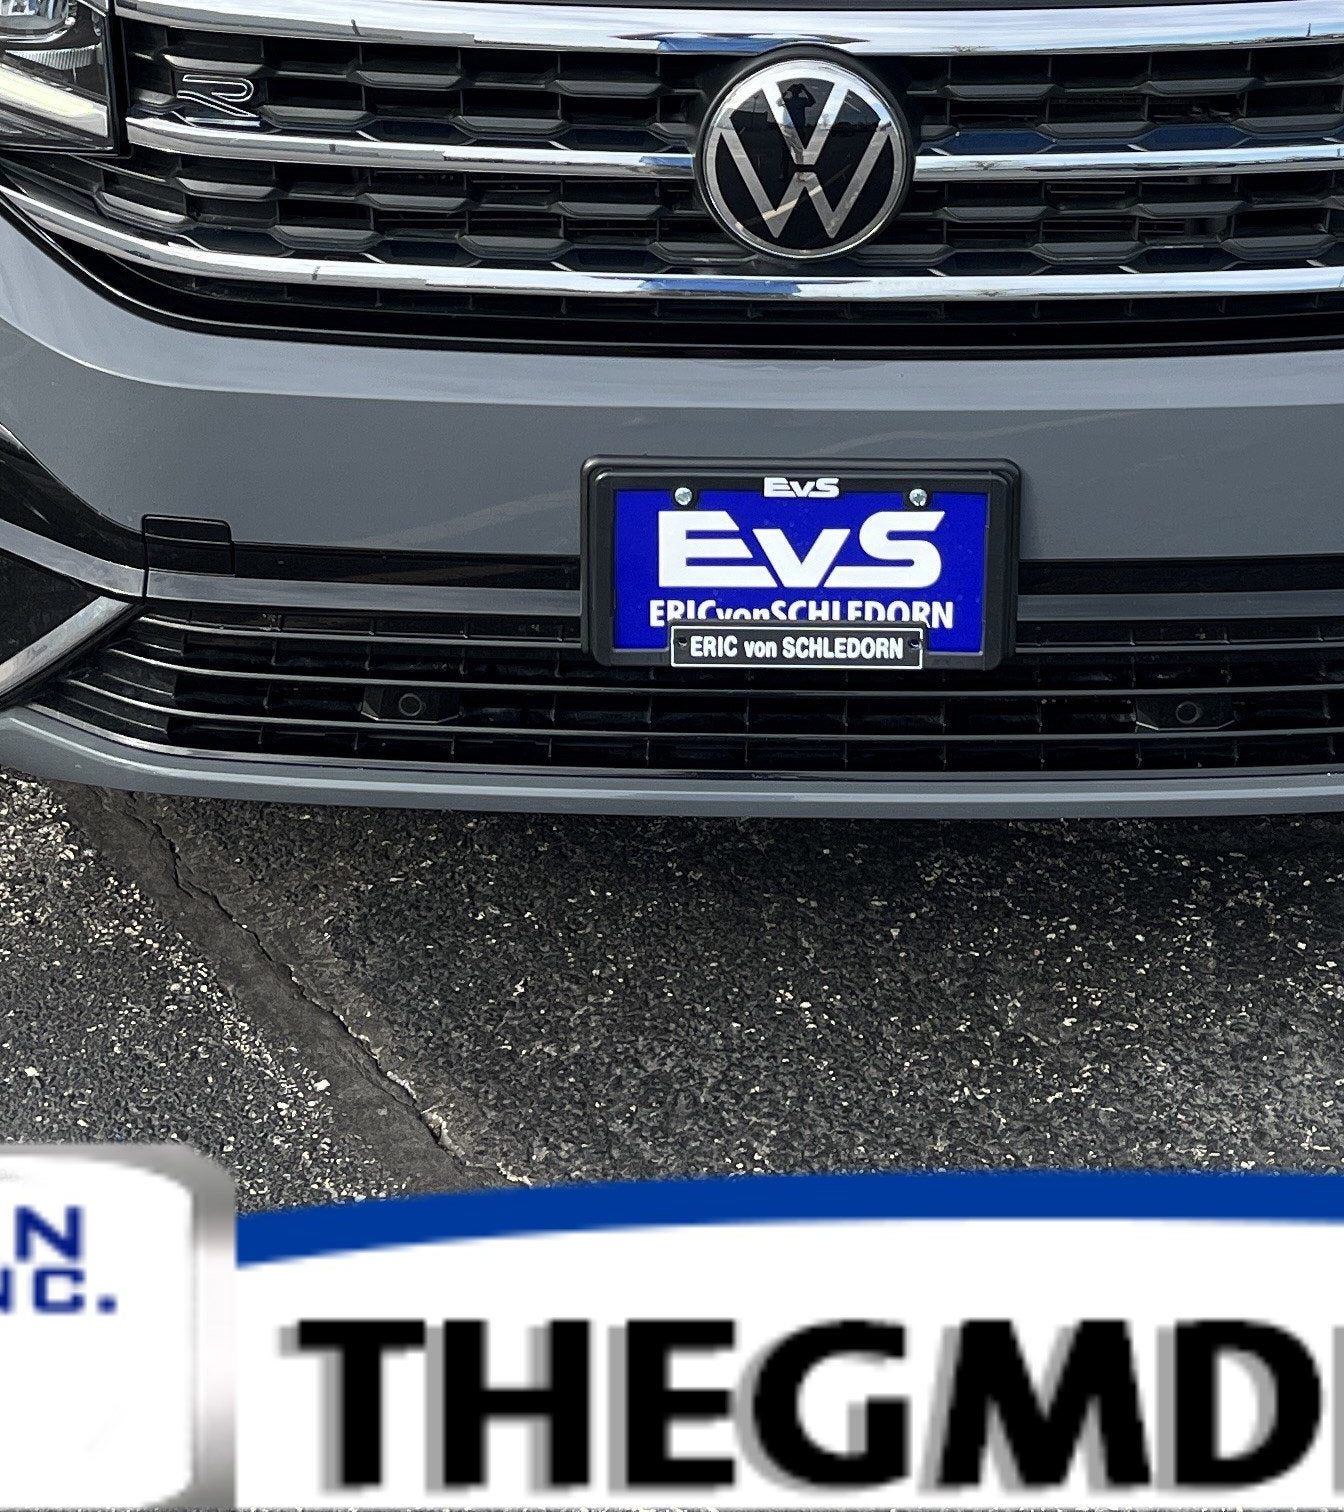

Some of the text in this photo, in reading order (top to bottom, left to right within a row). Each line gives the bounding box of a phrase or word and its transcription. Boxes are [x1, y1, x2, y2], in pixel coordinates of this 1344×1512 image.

[704, 56, 906, 258] VW
[690, 634, 904, 660] ERIC von SCHLEDORN
